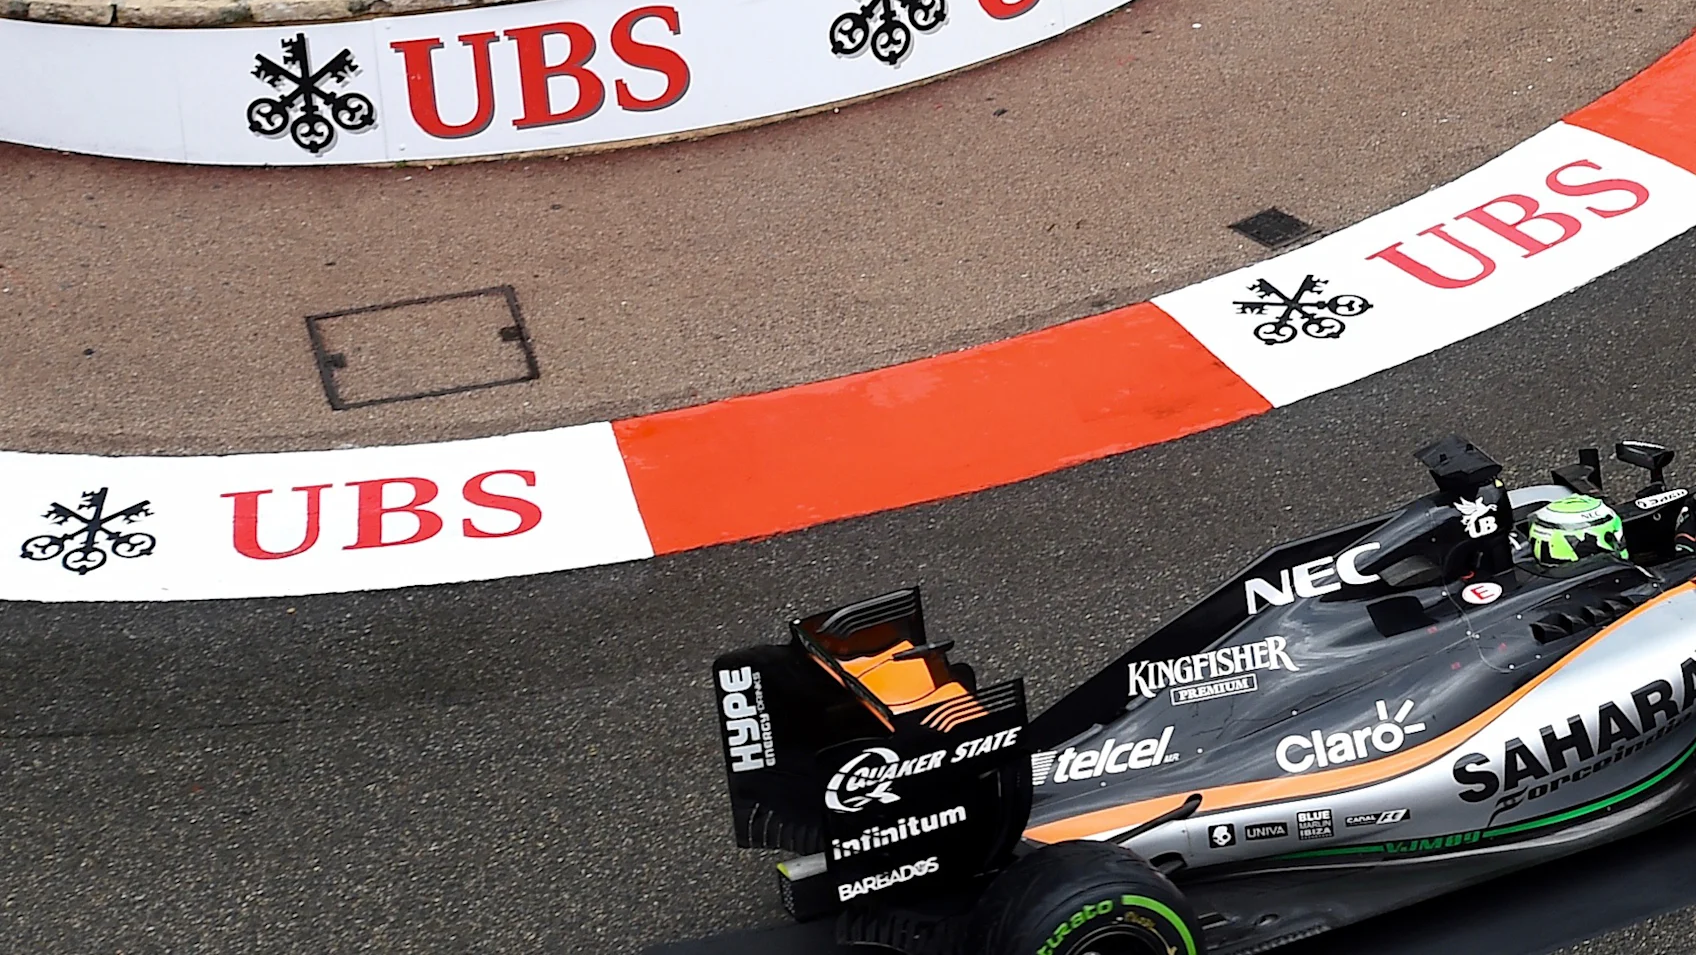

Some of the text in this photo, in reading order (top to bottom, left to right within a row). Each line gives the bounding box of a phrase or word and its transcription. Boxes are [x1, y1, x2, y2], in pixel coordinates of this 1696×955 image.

[391, 5, 692, 139] UBS
[1366, 158, 1650, 289] UBS
[221, 468, 543, 560] UBS
[1244, 541, 1382, 616] NEC
[1470, 584, 1494, 601] E
[1127, 634, 1301, 699] KINGFISHER
[1177, 678, 1249, 702] PREMIUM
[719, 665, 765, 773] HYPE
[1275, 718, 1405, 774] Claro
[846, 725, 1022, 792] QUAKER STATE
[1053, 725, 1176, 784] telcel
[831, 805, 967, 860] infinitum
[1246, 824, 1286, 839] UNIVA
[1298, 810, 1331, 823] BLUE
[838, 856, 940, 902] BARBADOS
